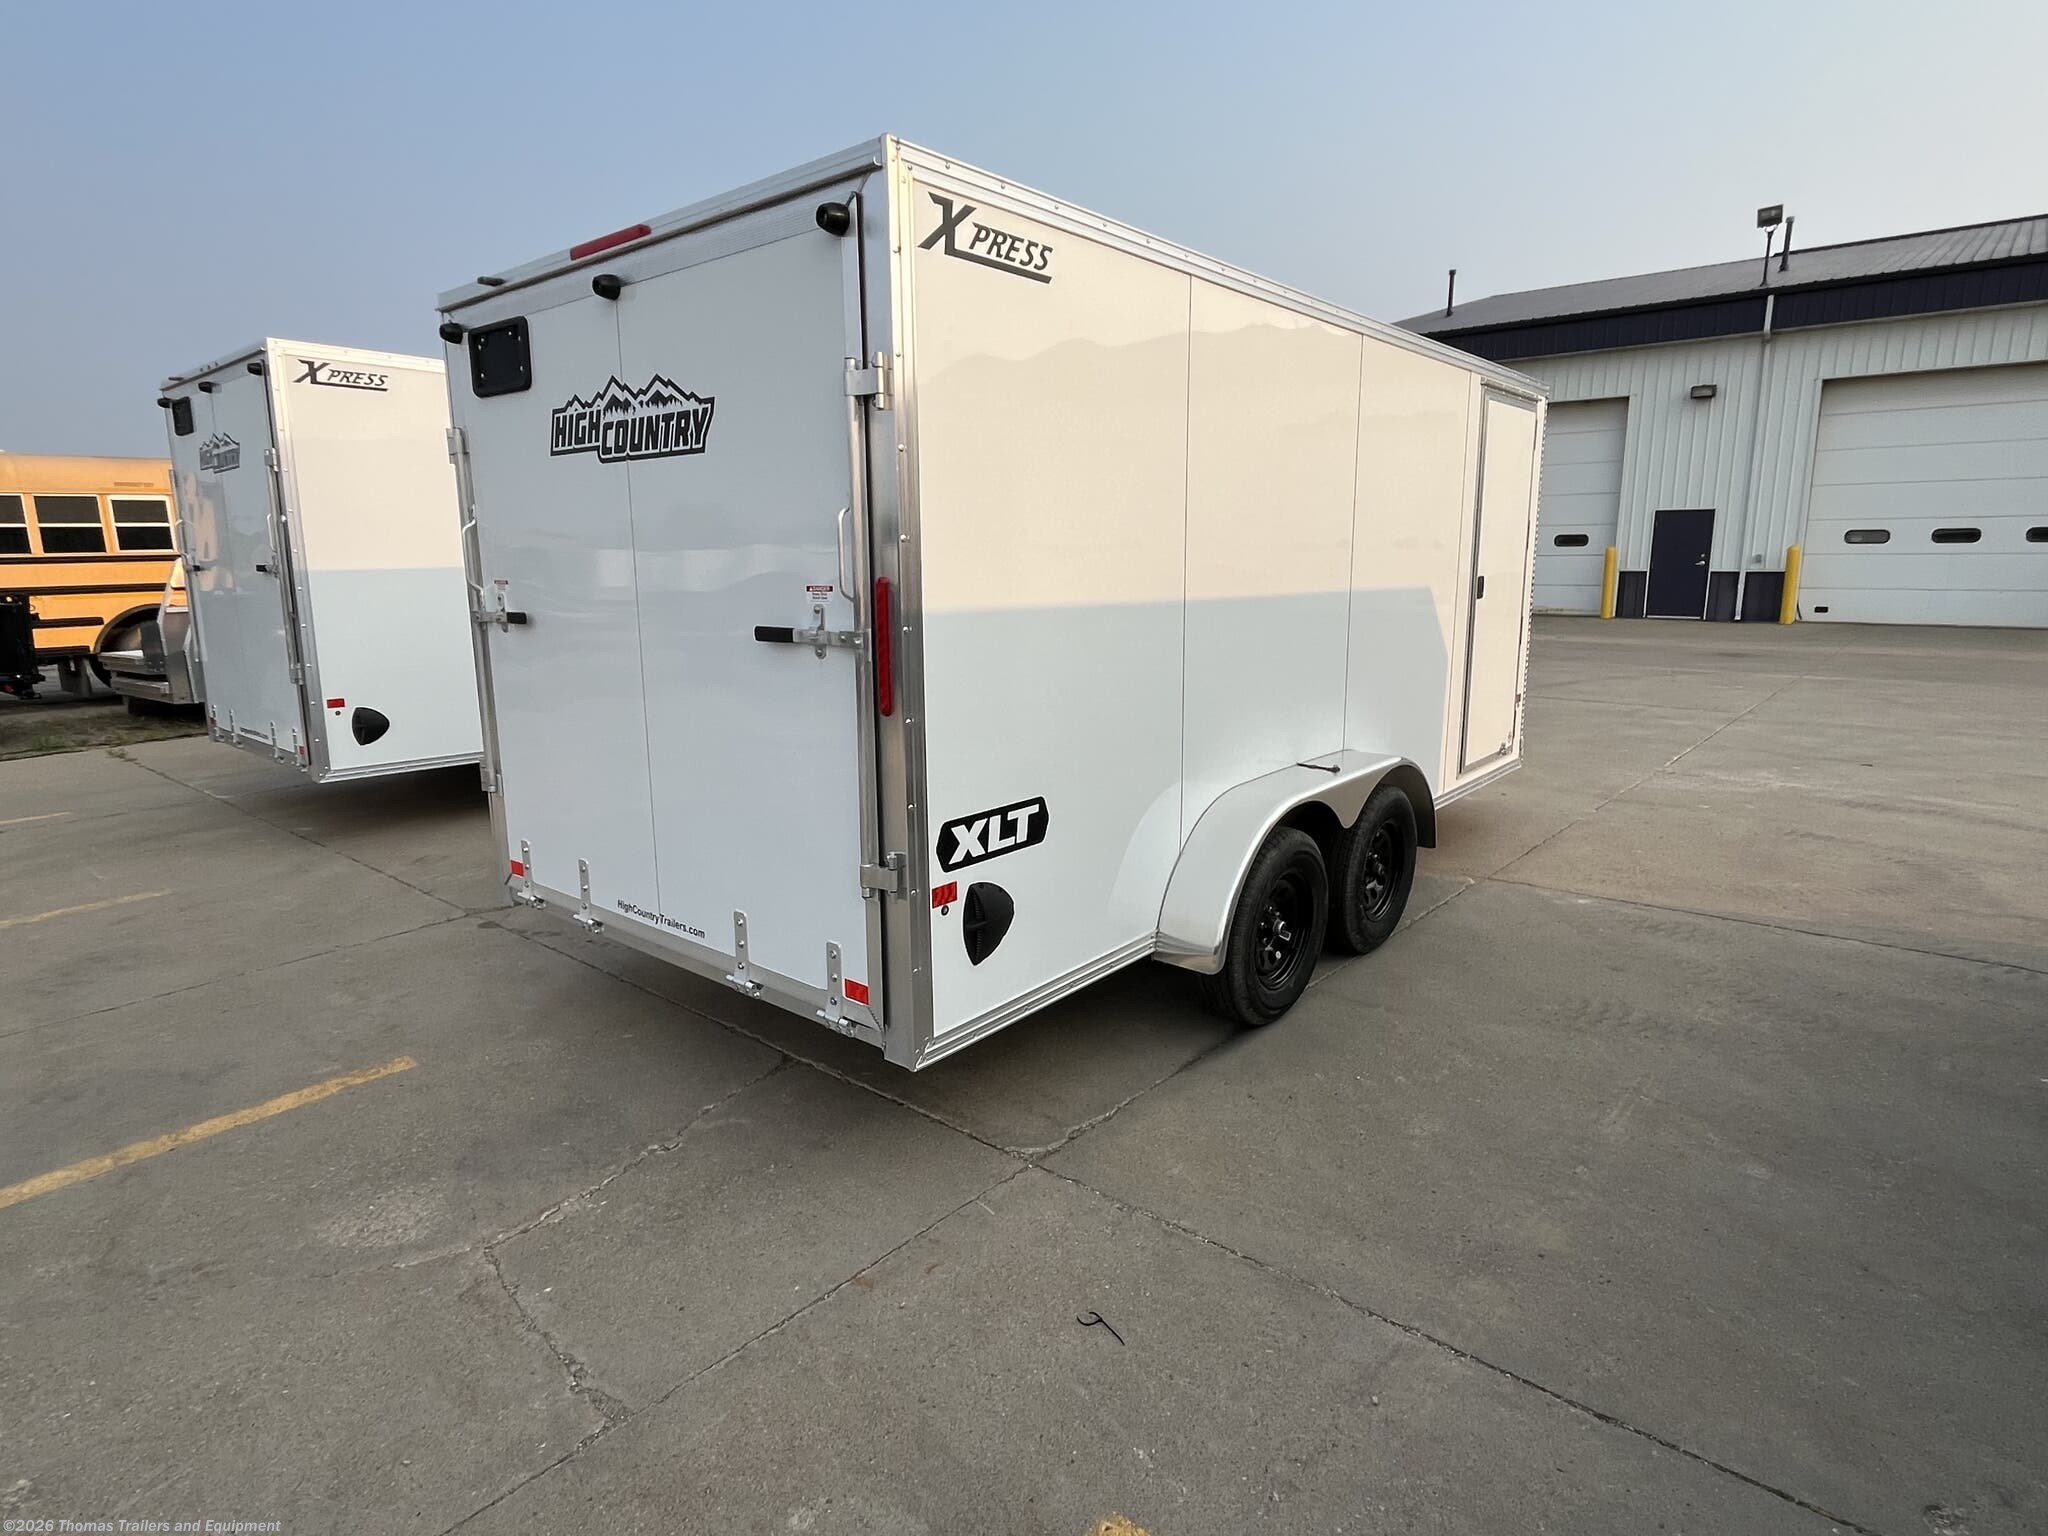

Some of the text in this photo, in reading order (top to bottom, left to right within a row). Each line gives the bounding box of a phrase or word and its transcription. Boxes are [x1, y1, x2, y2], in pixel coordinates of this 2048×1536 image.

[554, 406, 710, 455] HIGH COUNTRY
[948, 803, 1040, 865] XLT
[617, 899, 706, 938] HighCountryTrailers.com
